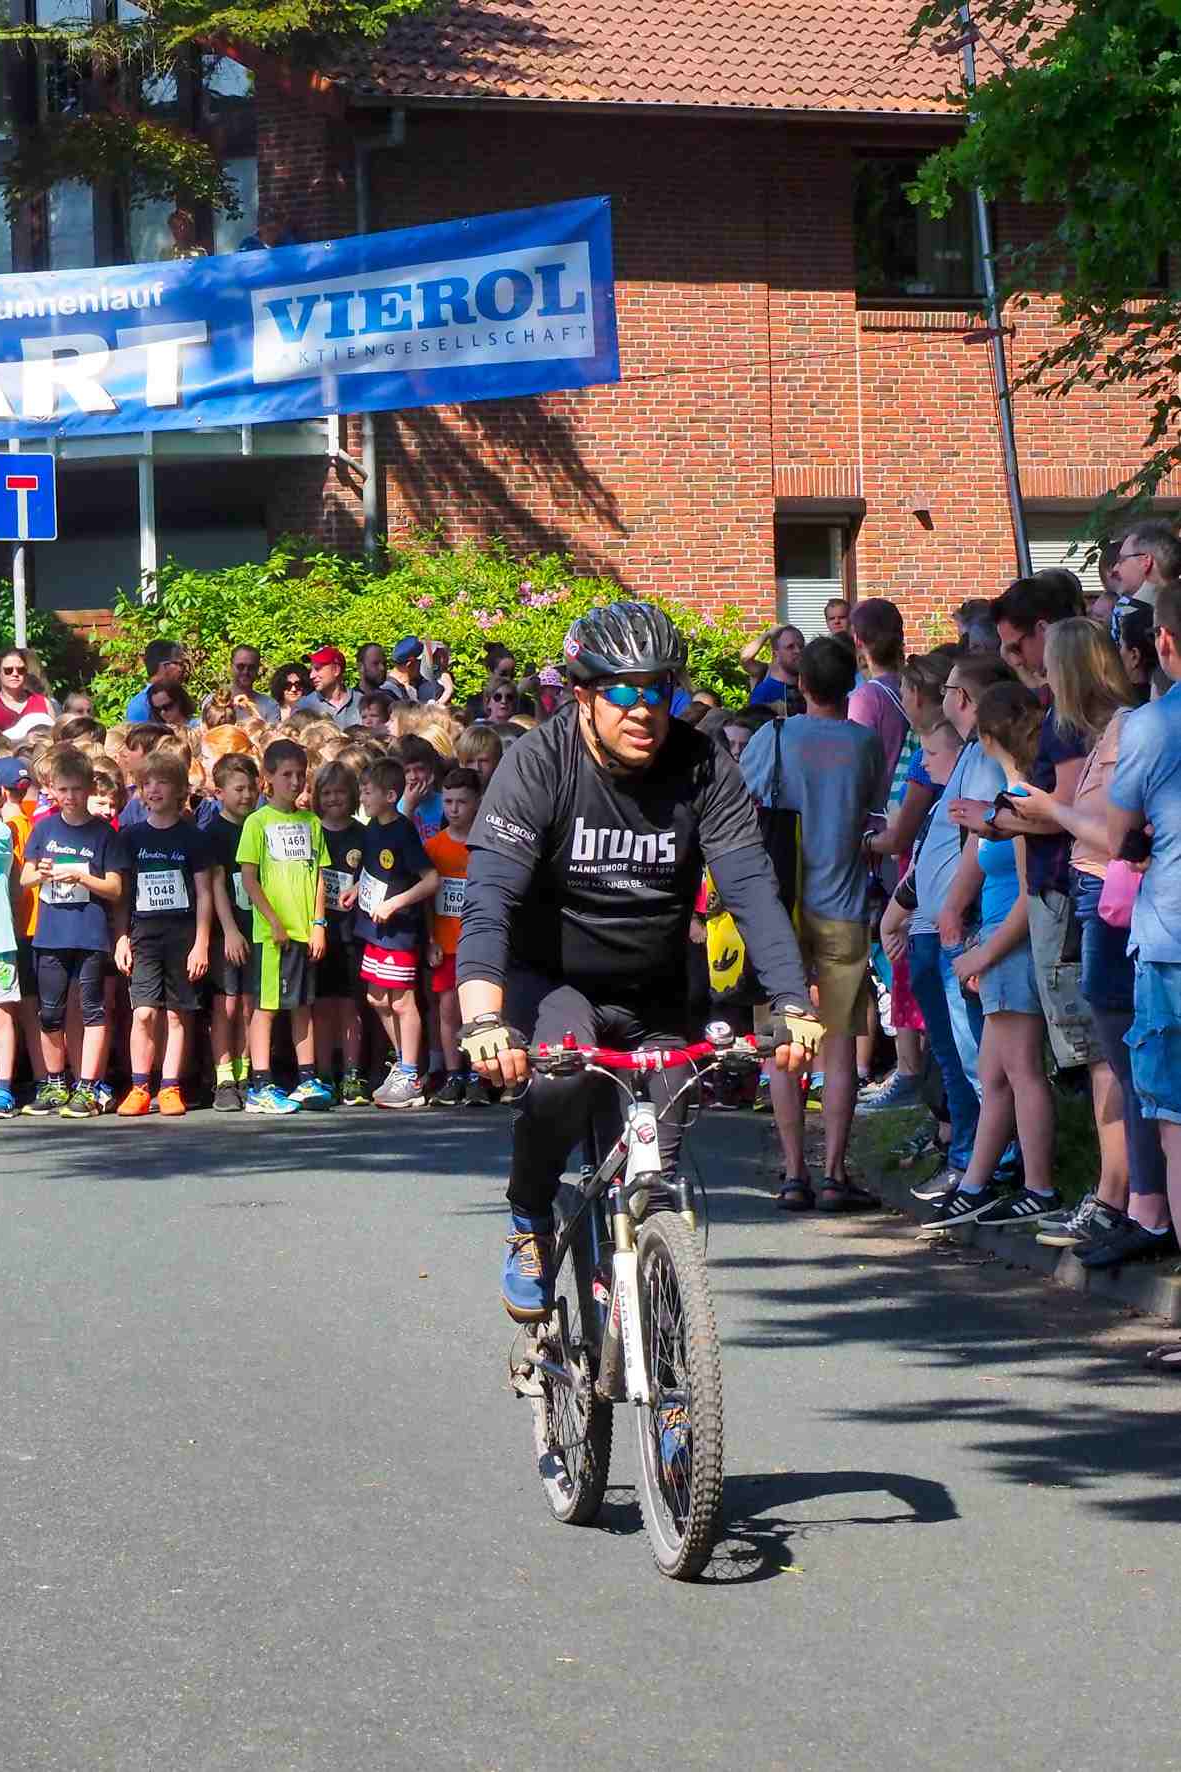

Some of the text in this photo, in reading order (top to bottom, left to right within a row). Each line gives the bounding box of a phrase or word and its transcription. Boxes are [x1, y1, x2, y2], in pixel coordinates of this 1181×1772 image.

[262, 262, 586, 345] VIEROL
[282, 835, 306, 847] 1469
[571, 817, 676, 864] bruns
[147, 884, 176, 897] 1048
[443, 891, 464, 903] 160
[443, 902, 461, 912] brun
